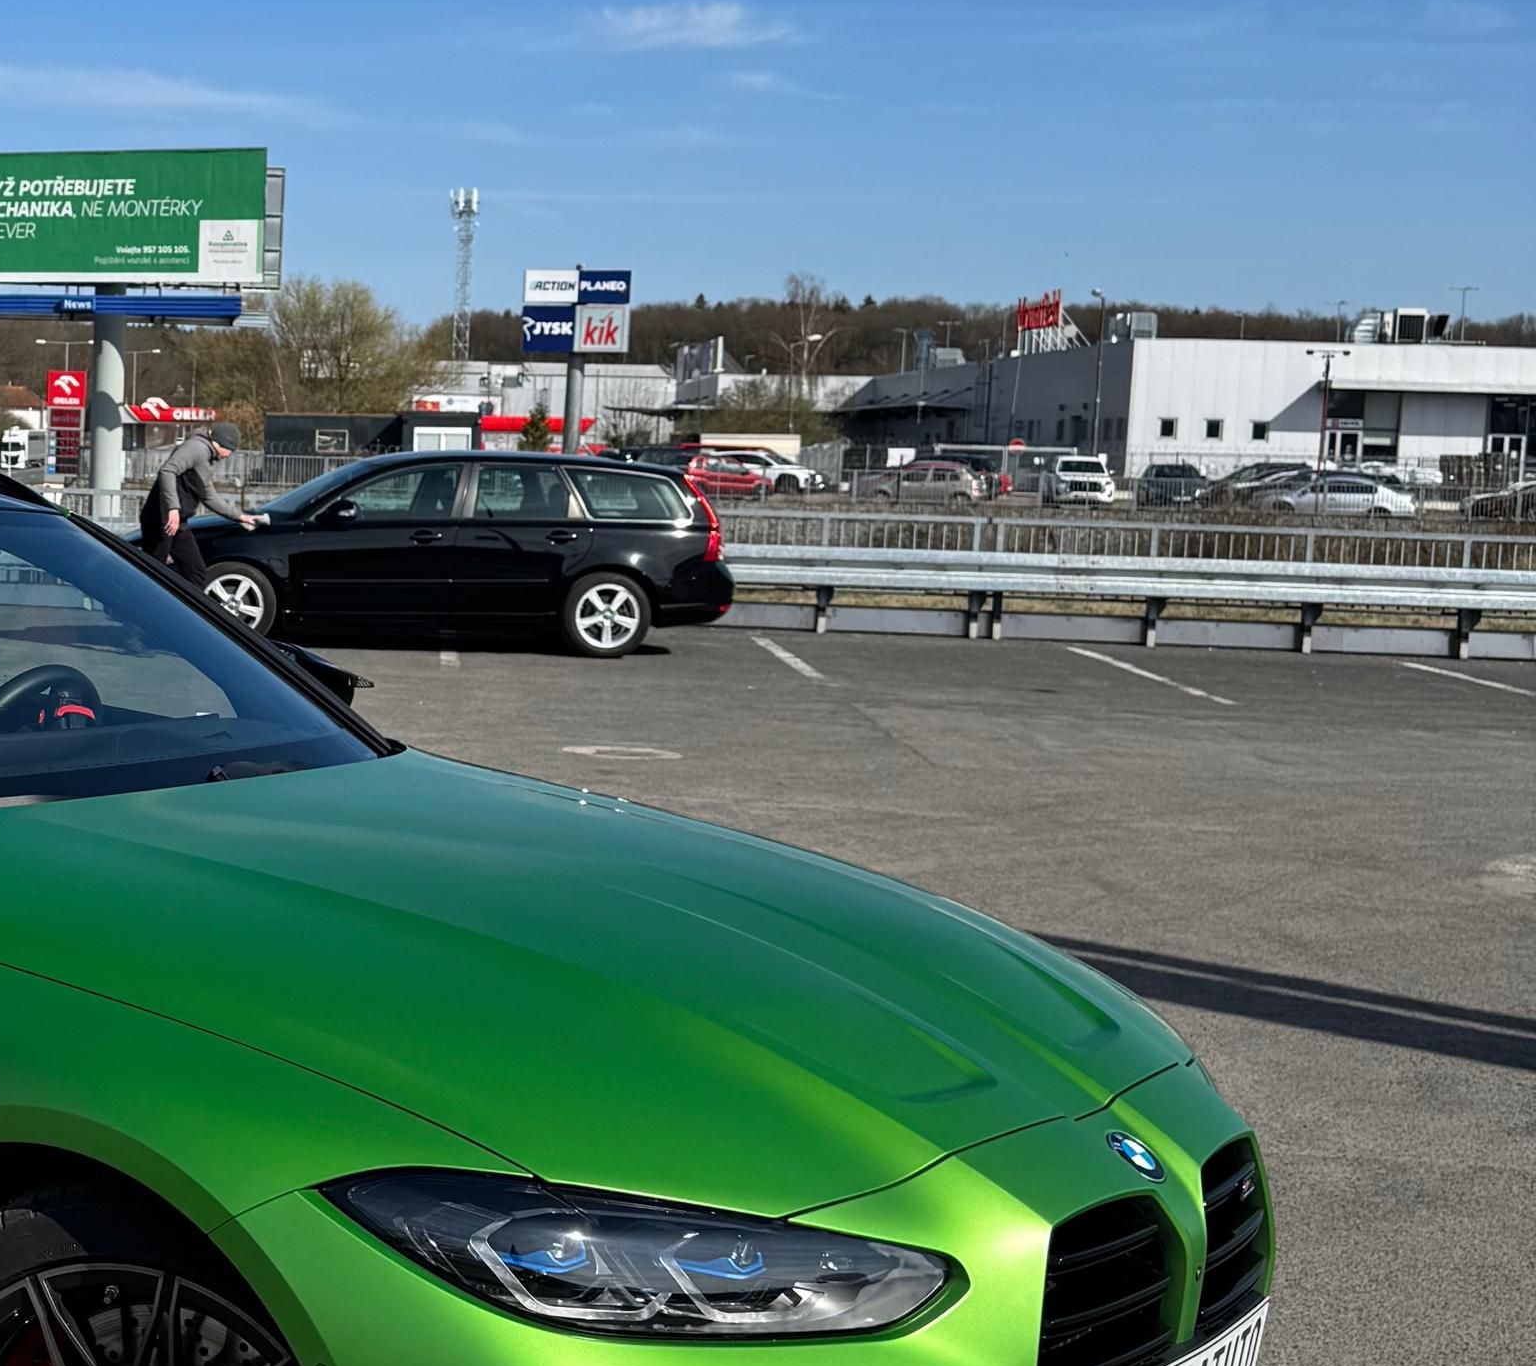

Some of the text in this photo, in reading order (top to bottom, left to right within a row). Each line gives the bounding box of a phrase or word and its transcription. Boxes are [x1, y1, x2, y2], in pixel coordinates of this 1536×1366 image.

[18, 175, 137, 198] POTŘEBUJETE
[80, 200, 105, 217] NE
[107, 195, 203, 217] MONTÉRKY
[158, 245, 173, 254] 105
[534, 280, 576, 291] ACTION
[580, 280, 627, 292] PLANEO
[64, 299, 92, 310] News
[533, 321, 573, 336] JYSK
